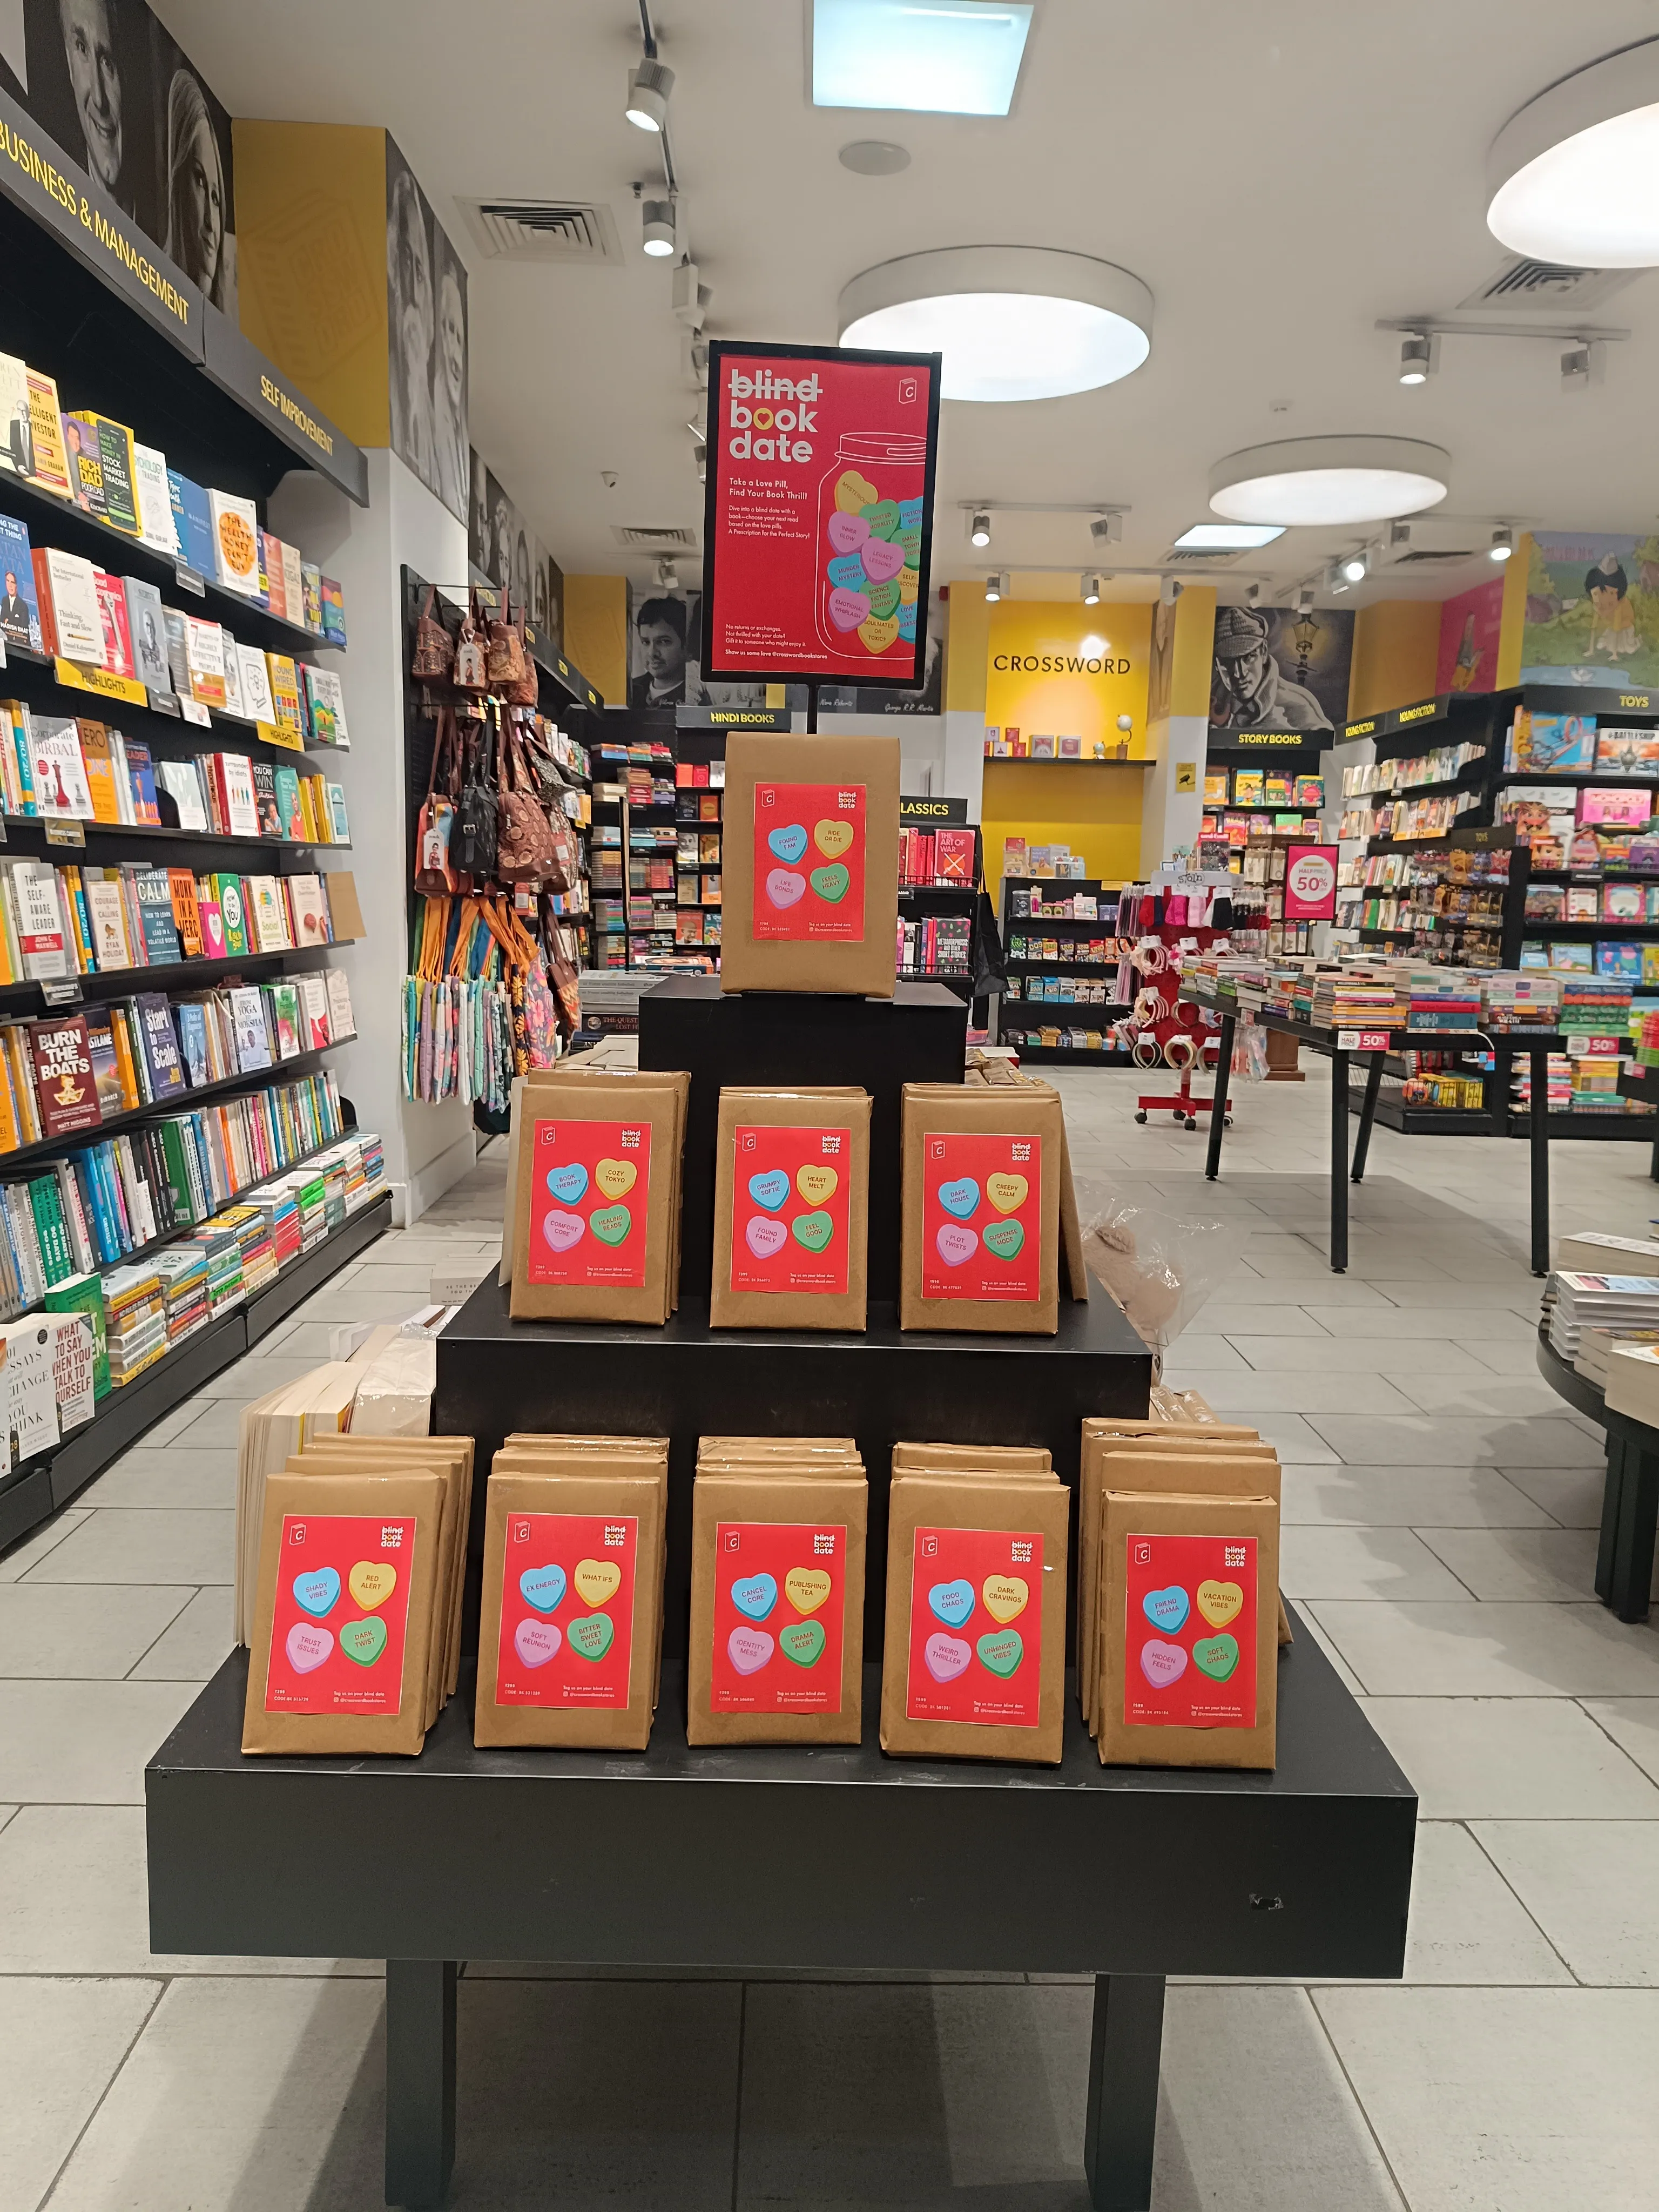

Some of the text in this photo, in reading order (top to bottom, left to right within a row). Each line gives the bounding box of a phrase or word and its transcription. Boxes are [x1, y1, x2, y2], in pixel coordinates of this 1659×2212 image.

[0, 119, 188, 325] BUSINESS & MANAGEMENT
[729, 369, 822, 402] blind
[906, 387, 913, 397] C
[261, 375, 333, 456] SELF IMPROVEMENT
[731, 400, 818, 433] book
[730, 431, 812, 463] date
[78, 456, 102, 475] RICH
[103, 455, 121, 468] STOCK
[103, 463, 126, 478] MARKET
[80, 469, 103, 488] DAD
[105, 473, 129, 489] TRADING
[775, 480, 788, 489] Pill,
[787, 491, 807, 500] Thrill!
[227, 516, 241, 528] THE
[220, 523, 252, 540] WEALTH
[841, 525, 857, 534] INNER
[224, 536, 249, 550] MONEY
[840, 533, 855, 542] GLOW
[227, 548, 248, 562] CAN'T
[232, 561, 245, 571] BUY
[838, 564, 859, 574] MURDER
[838, 571, 862, 582] MYSTERY
[835, 599, 864, 612] EMOTIONAL
[835, 607, 860, 619] WHIPLASH
[994, 655, 1130, 674] CROSSWORD
[81, 672, 126, 694] HIGHLIGHTS
[1620, 696, 1649, 707] TOYS
[711, 712, 775, 723] HINDI BOOKS
[1400, 703, 1436, 722] YOUNG FICTION
[31, 728, 75, 741] Corporate
[1346, 721, 1374, 737] YOUNG FICTION
[1239, 734, 1302, 744] STORY BOOKS
[36, 742, 78, 756] BIRBAL
[225, 761, 249, 769] surrounded
[253, 765, 272, 775] YOU CAN
[235, 769, 247, 777] idiots
[256, 776, 273, 789] WIN
[900, 802, 948, 815] LASSICS
[779, 836, 797, 845] FOUND
[25, 875, 37, 886] THE
[136, 871, 168, 880] DELIBERATE
[173, 879, 193, 899] MONK
[775, 885, 793, 893] BONDS
[822, 879, 840, 889] HEAVY
[1297, 877, 1327, 891] 50%
[27, 890, 45, 901] SELF-
[137, 882, 171, 901] CALM
[30, 904, 51, 915] AWARE
[179, 900, 193, 918] IN A
[32, 918, 56, 929] LEADER
[179, 920, 198, 939] MERC
[1028, 941, 1042, 950] DOS
[238, 1005, 257, 1017] YOGA
[145, 1007, 170, 1031] Start
[238, 1018, 262, 1030] MOKSHA
[38, 1029, 82, 1050] BURN
[150, 1033, 158, 1046] to
[1363, 1035, 1386, 1046] 50%
[46, 1044, 79, 1063] THE
[152, 1044, 177, 1070] Scale
[41, 1058, 90, 1081] BOATS
[559, 1174, 575, 1182] BOOK
[556, 1179, 581, 1189] THERAPY
[950, 1189, 966, 1198] DARK
[950, 1195, 969, 1204] HOUSE
[550, 1220, 578, 1232] COMFORT
[598, 1215, 623, 1226] HEALING
[603, 1222, 622, 1231] READS
[555, 1229, 569, 1237] CORE
[989, 1229, 1017, 1242] SUSPENSE
[950, 1235, 965, 1243] PLOT
[996, 1237, 1013, 1245] MODE
[946, 1240, 966, 1250] TWISTS
[57, 1321, 80, 1343] WHAT
[55, 1334, 83, 1358] TO SAY
[73, 1347, 90, 1365] YOU
[55, 1364, 85, 1390] TALK TO
[536, 1579, 561, 1590] ENERGY
[997, 1586, 1015, 1594] DARK
[942, 1592, 960, 1600] FOOD
[989, 1593, 1021, 1603] CRAVINGS
[1203, 1593, 1237, 1602] VACATION
[941, 1599, 963, 1608] CHAOS
[1155, 1598, 1177, 1609] FRIEND
[1156, 1606, 1179, 1616] DRAMA
[579, 1623, 601, 1635] BITTER
[530, 1631, 547, 1641] SOFT
[581, 1631, 602, 1642] SWEET
[523, 1637, 550, 1650] REUNION
[585, 1638, 602, 1648] LOVE
[984, 1641, 1016, 1655] UNHINGED
[939, 1645, 959, 1656] WEIRD
[993, 1651, 1011, 1660] VIBES
[1208, 1647, 1223, 1656] SOFT
[933, 1651, 961, 1665] THRILLER
[1152, 1653, 1176, 1664] HIDDEN
[1206, 1653, 1229, 1664] CHAOS
[1152, 1661, 1171, 1670] FEELS
